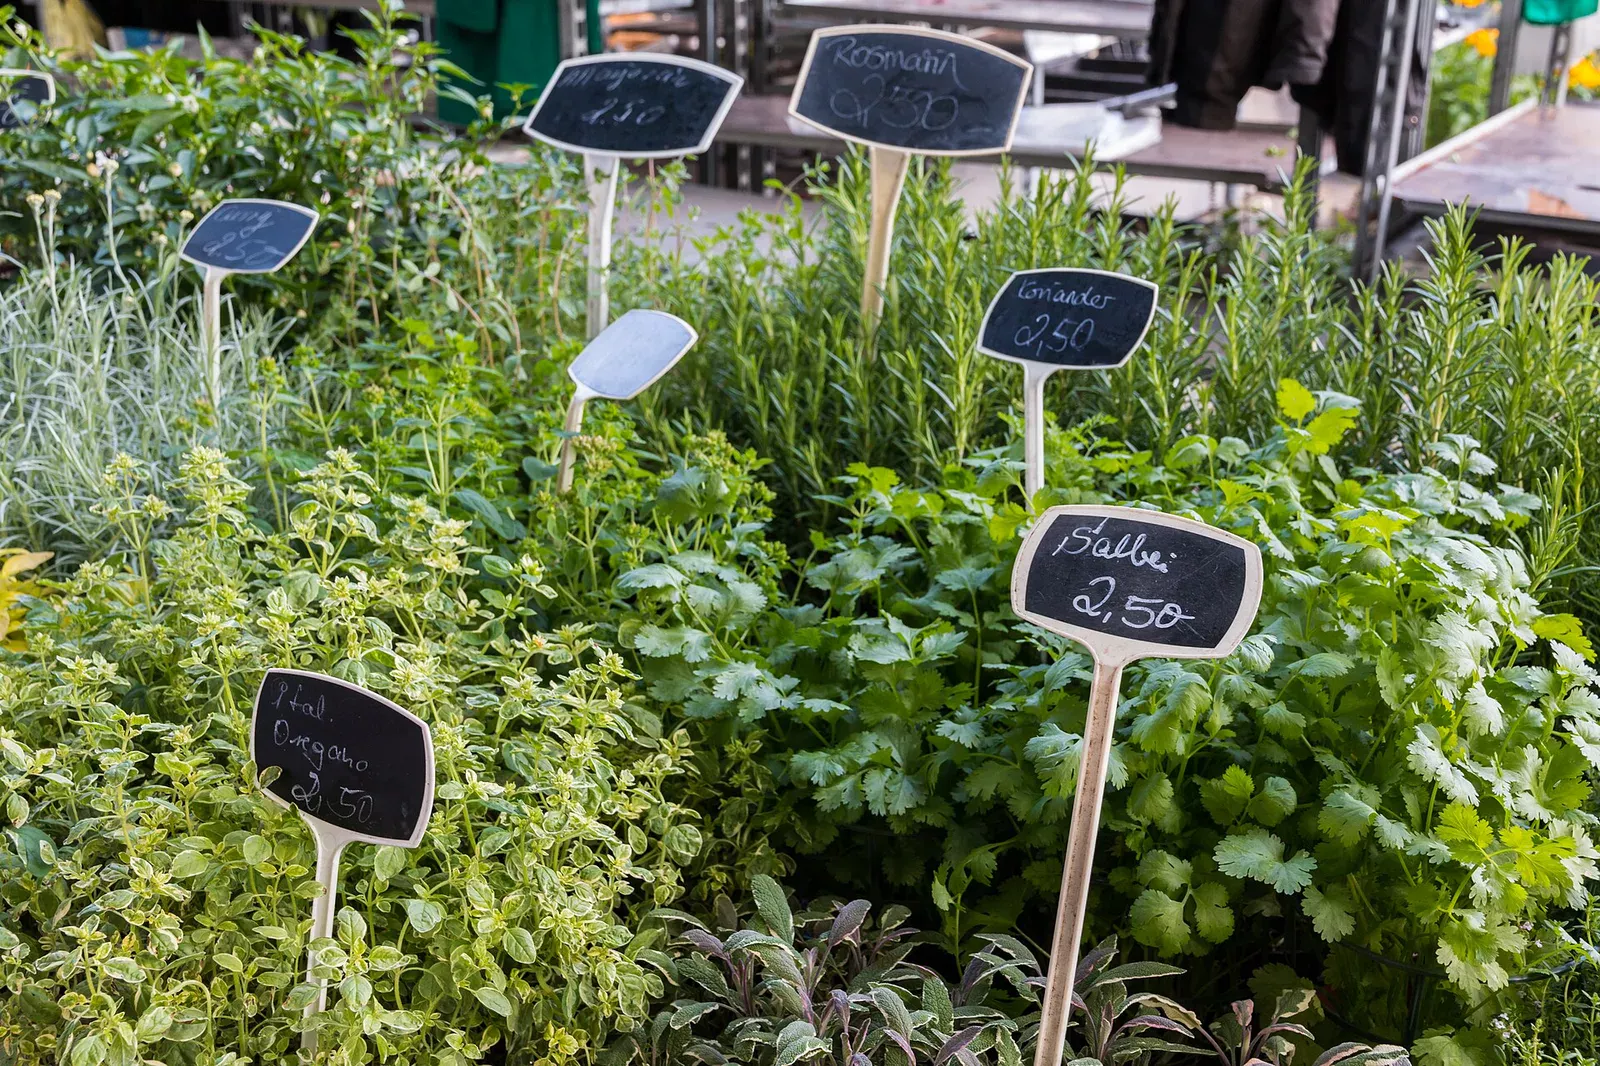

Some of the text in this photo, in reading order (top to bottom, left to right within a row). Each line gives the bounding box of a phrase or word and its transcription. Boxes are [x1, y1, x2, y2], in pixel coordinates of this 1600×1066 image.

[826, 36, 970, 91] Rosmarin
[830, 73, 958, 130] 2,50
[1018, 279, 1116, 309] Koriander
[1014, 314, 1095, 356] 2,50
[1052, 517, 1177, 573] Salbei
[1072, 576, 1195, 629] 2,50
[274, 719, 368, 772] Oregano
[291, 771, 373, 823] 2,50
